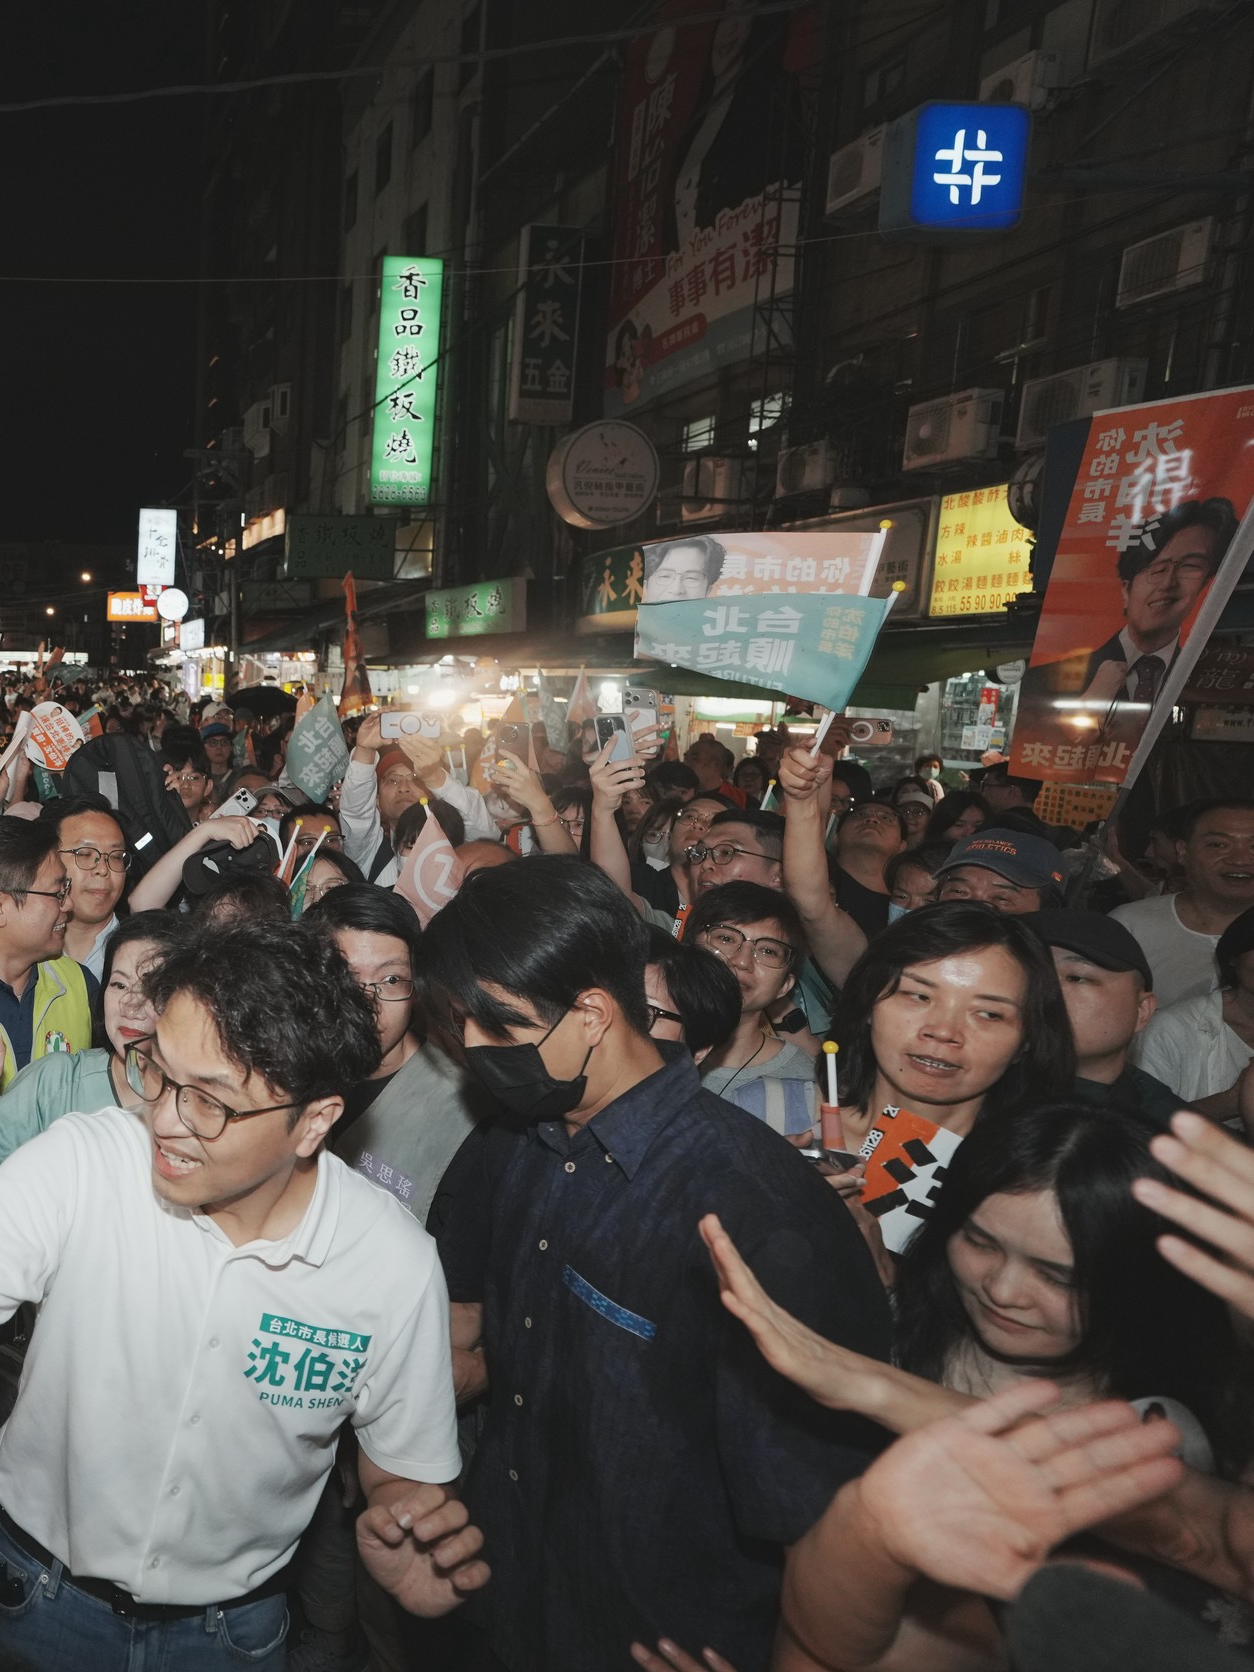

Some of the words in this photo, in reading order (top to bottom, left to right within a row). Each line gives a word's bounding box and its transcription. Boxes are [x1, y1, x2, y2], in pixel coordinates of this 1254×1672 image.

[529, 240, 575, 348] 永來
[385, 266, 427, 464] 香品鐵板燒
[521, 358, 571, 393] 五金
[359, 1151, 413, 1199] 吳思瑤
[269, 1318, 365, 1351] 台北市長候選人
[259, 1392, 303, 1408] PUMA
[308, 1397, 345, 1409] SHEN
